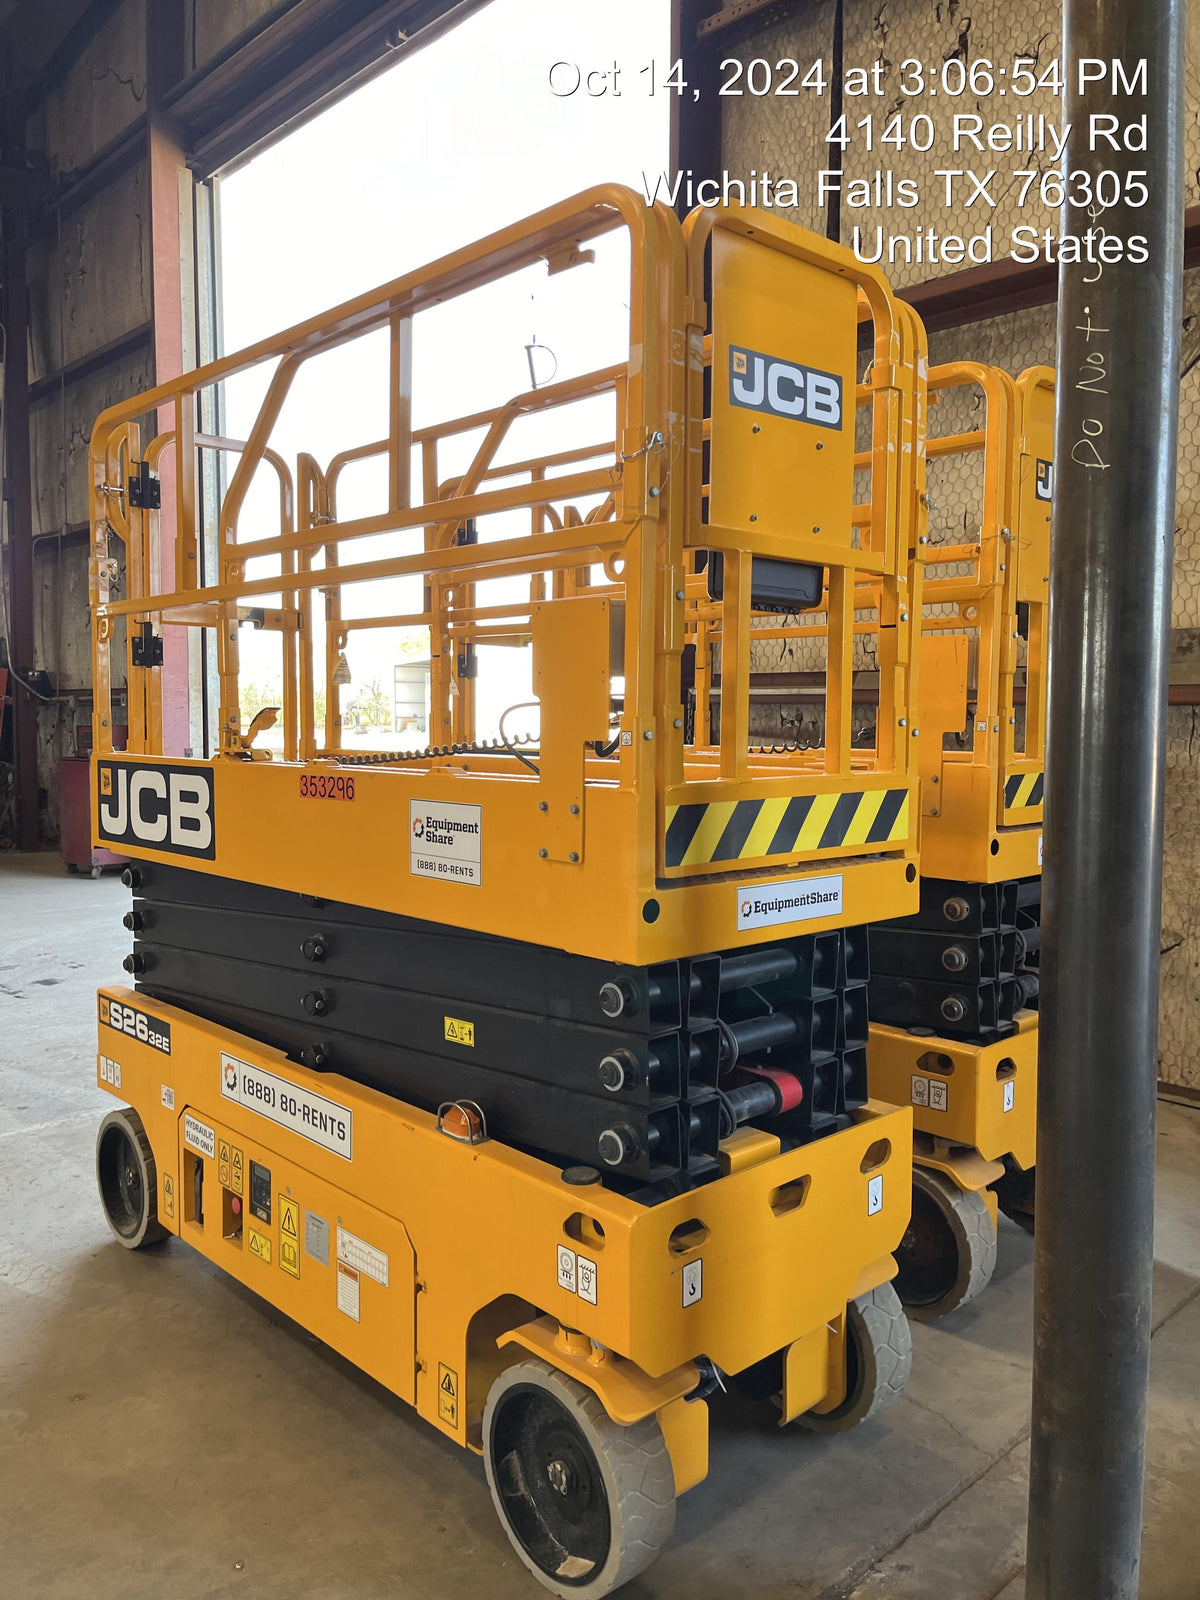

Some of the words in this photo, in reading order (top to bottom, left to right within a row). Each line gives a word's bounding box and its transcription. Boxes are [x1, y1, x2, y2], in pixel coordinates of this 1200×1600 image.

[733, 357, 841, 424] JCB
[300, 774, 355, 800] 353296
[101, 769, 212, 849] JCB
[426, 816, 479, 834] Equipment
[426, 831, 454, 845] Share
[417, 859, 436, 872] (888)
[438, 863, 474, 877] 80-RENTS
[754, 891, 839, 915] EquipmentShare
[243, 1075, 276, 1108] (888)
[280, 1094, 346, 1141] 80-RENTS
[185, 1118, 214, 1142] HYDRAULIC
[186, 1130, 200, 1146] FLUID
[200, 1139, 213, 1153] ONLY
